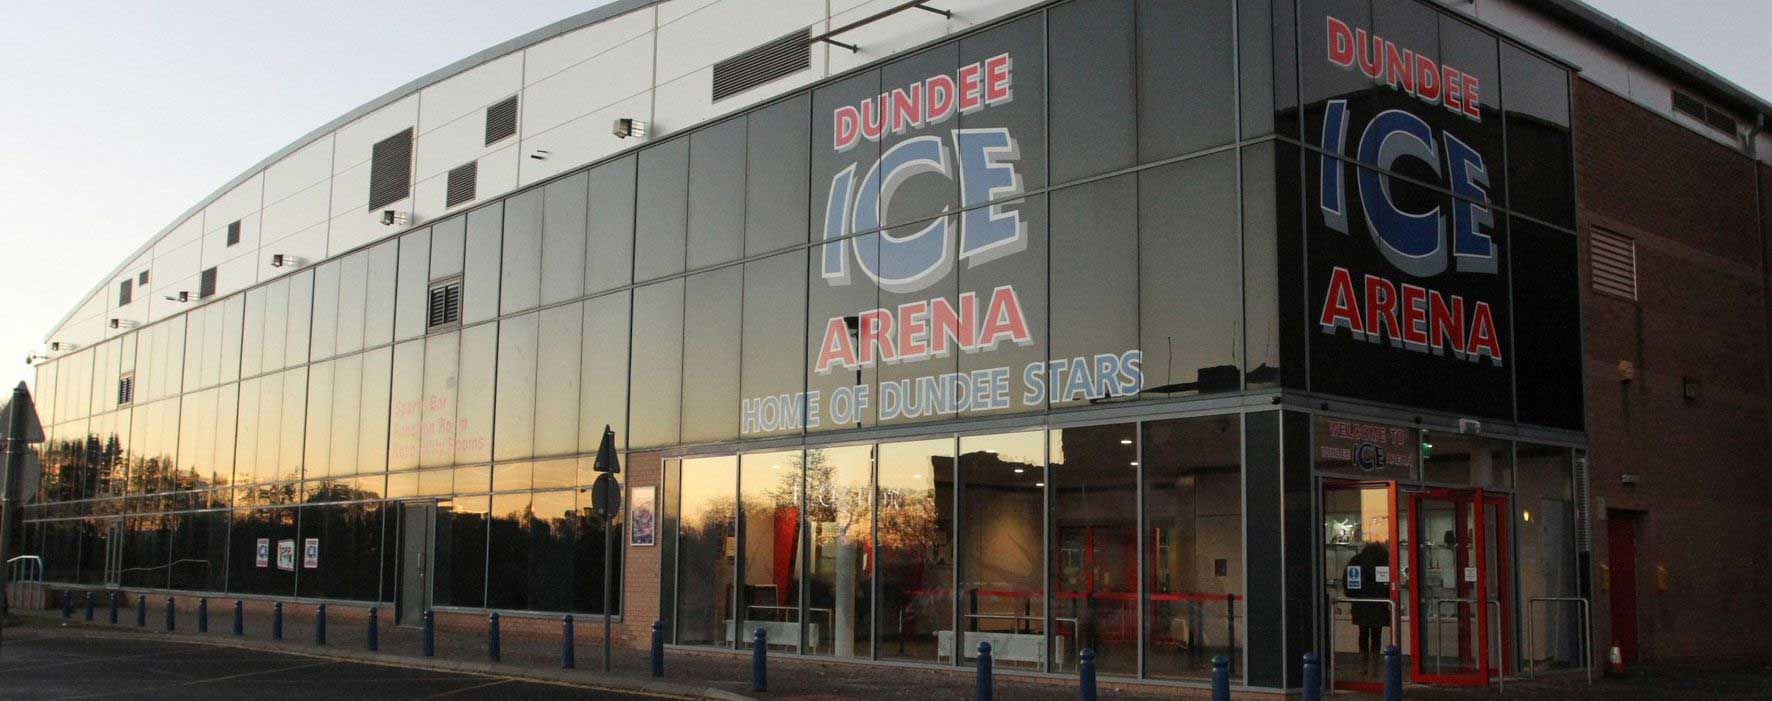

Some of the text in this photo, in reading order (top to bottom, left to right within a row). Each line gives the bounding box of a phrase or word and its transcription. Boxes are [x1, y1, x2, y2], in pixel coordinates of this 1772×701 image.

[833, 52, 1013, 152] DUNDEE
[1327, 16, 1481, 122] DUNDEE
[821, 127, 1028, 294] ICE
[1320, 99, 1498, 278] ICE
[814, 284, 1034, 376] ARENA
[1320, 266, 1503, 367] ARENA
[741, 350, 1144, 434] HOME OF DUNDEE STARS
[1328, 420, 1408, 446] WELCOME TO
[1352, 441, 1386, 472] ICE
